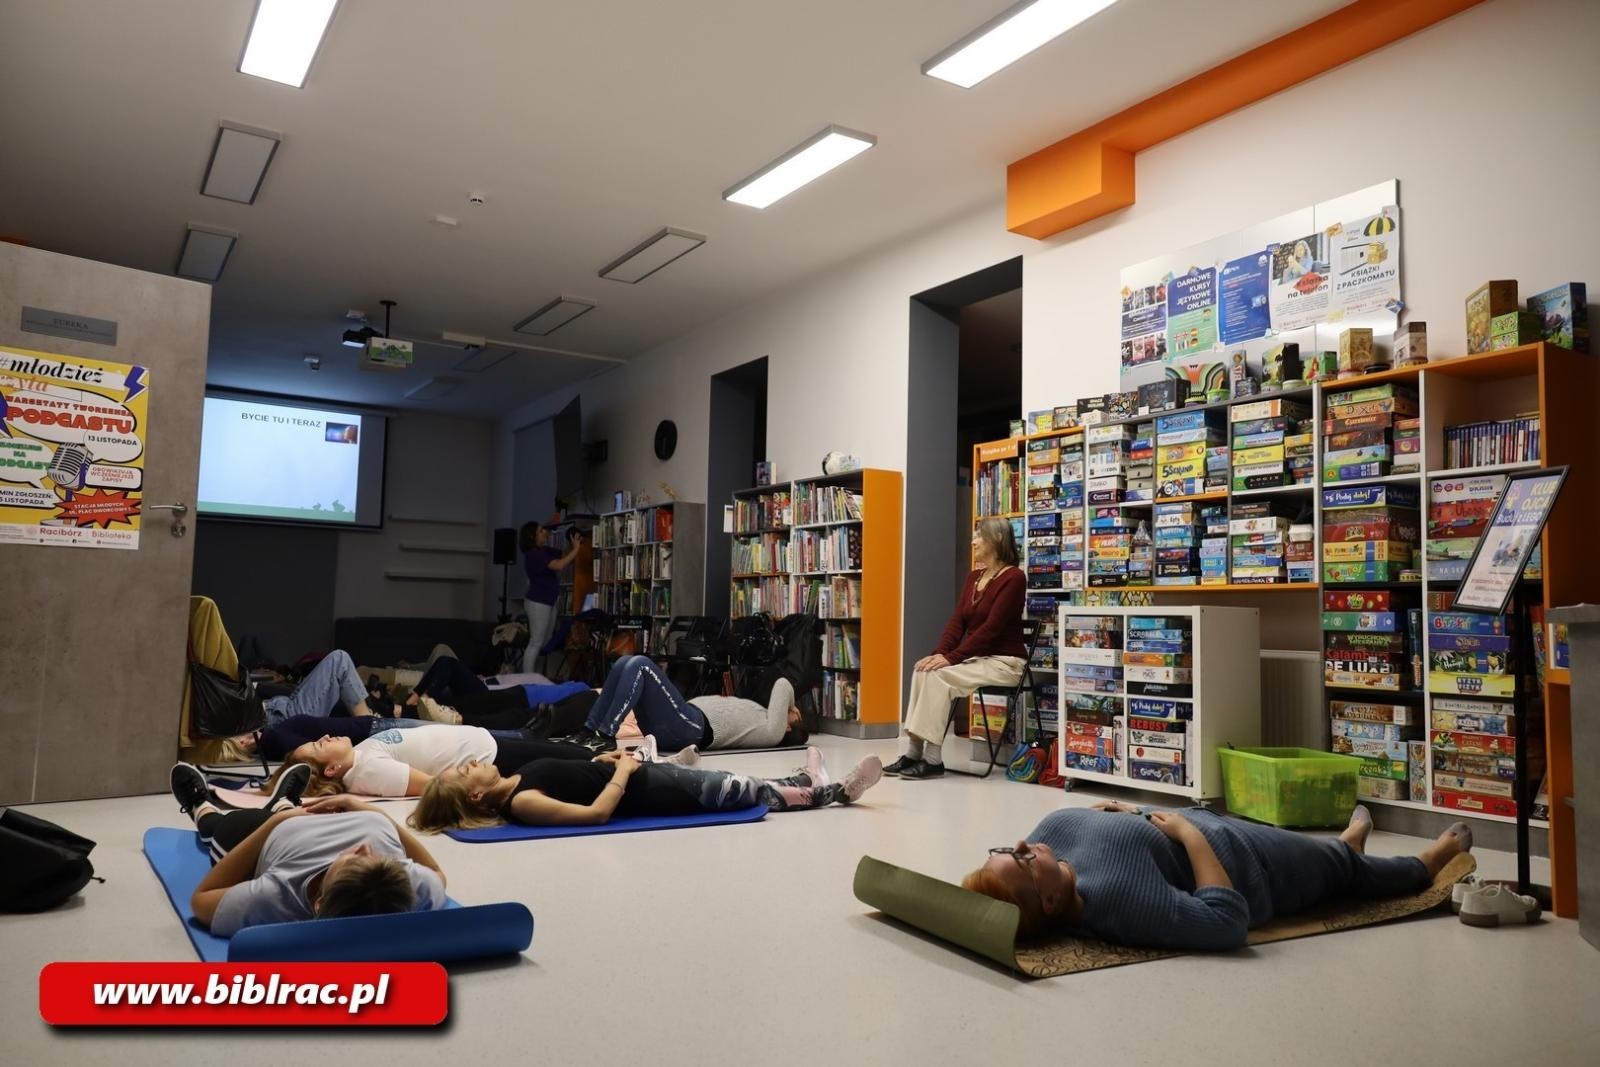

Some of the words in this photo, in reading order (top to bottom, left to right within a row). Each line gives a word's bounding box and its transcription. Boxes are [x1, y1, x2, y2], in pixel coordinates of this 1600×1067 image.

[1177, 272, 1211, 288] DARMOWE
[1189, 280, 1211, 293] KURSY
[241, 412, 269, 423] BYCIE
[273, 416, 284, 424] TU
[292, 418, 321, 428] TERAZ
[40, 527, 82, 537] Racibórz
[1131, 719, 1168, 732] REBUSY
[1080, 755, 1098, 768] Reef
